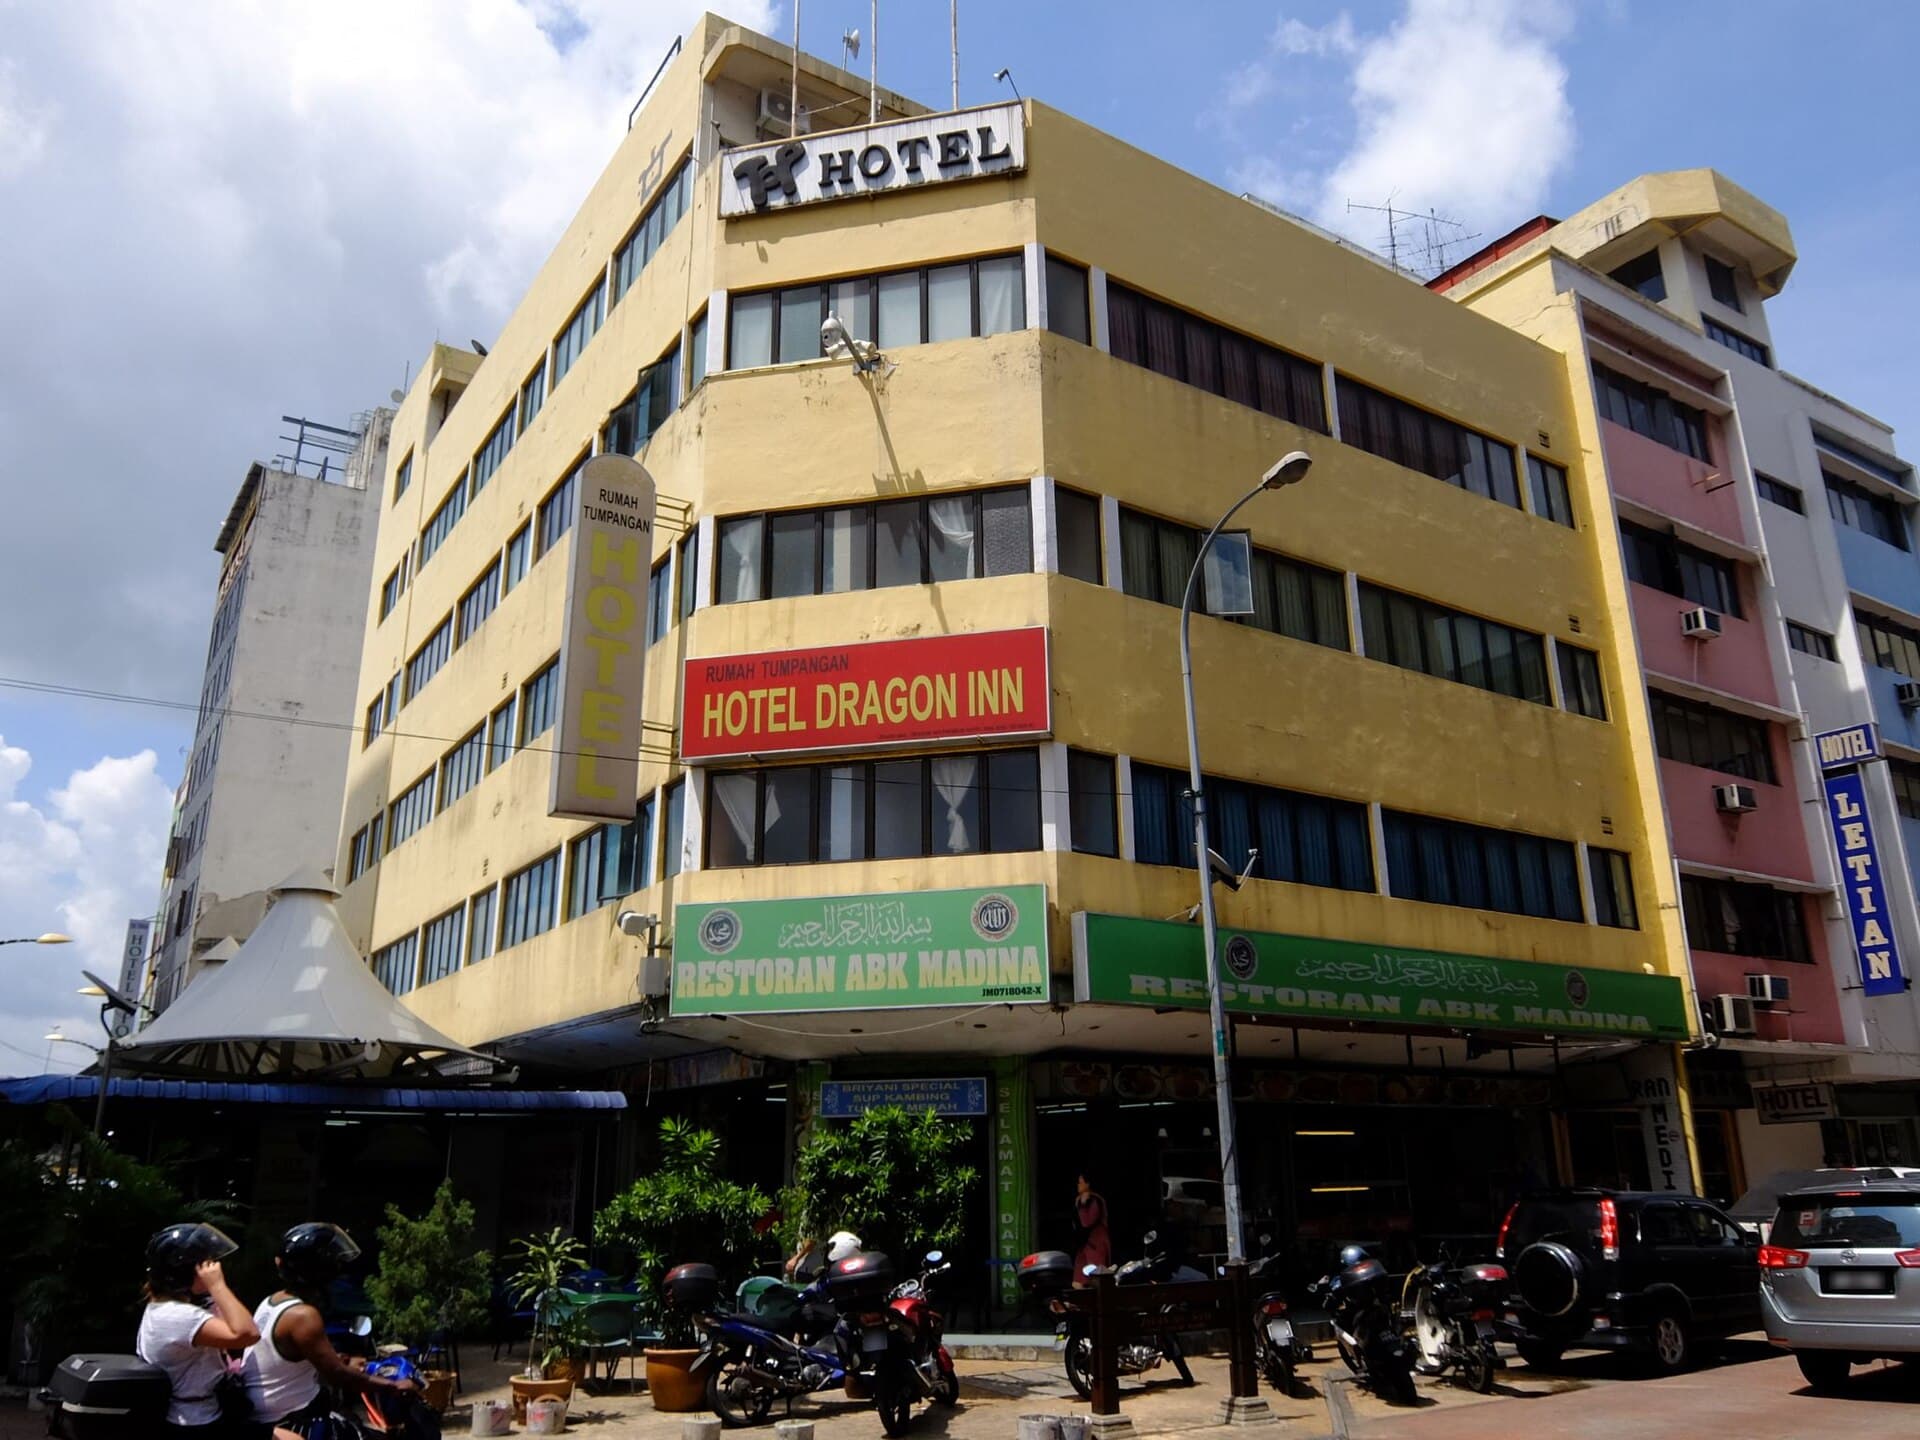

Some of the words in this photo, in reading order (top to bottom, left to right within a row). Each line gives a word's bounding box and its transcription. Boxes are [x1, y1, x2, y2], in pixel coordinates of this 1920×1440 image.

[818, 126, 1011, 188] HOTEL
[583, 505, 650, 534] TUMPANGAN
[599, 488, 639, 509] RUMAH
[576, 531, 639, 800] HOTEL
[706, 661, 755, 683] RUMAH
[761, 654, 849, 680] TUMPANGAN
[703, 686, 807, 738] HOTEL
[816, 673, 957, 730] DRAGON
[968, 667, 1024, 717] INN
[1819, 729, 1873, 763] HOTEL
[1833, 792, 1892, 980] LETIAN
[126, 934, 144, 993] HOTEL
[676, 954, 837, 998] RESTORAN
[845, 951, 909, 992] ABK
[917, 946, 1042, 988] MADINA
[1129, 974, 1401, 1013] RESTORAN
[1416, 998, 1500, 1021] ABK
[1513, 1005, 1651, 1032] MADINA
[842, 1083, 899, 1093] BRIYANI
[902, 1082, 960, 1092] SPECIAL
[852, 1094, 881, 1103] SUP
[884, 1092, 951, 1102] KAMBING
[1759, 1086, 1828, 1113] HOTEL
[998, 1087, 1013, 1192] SELAMAT
[1799, 1211, 1814, 1225] P
[1001, 1213, 1016, 1305] DATANG
